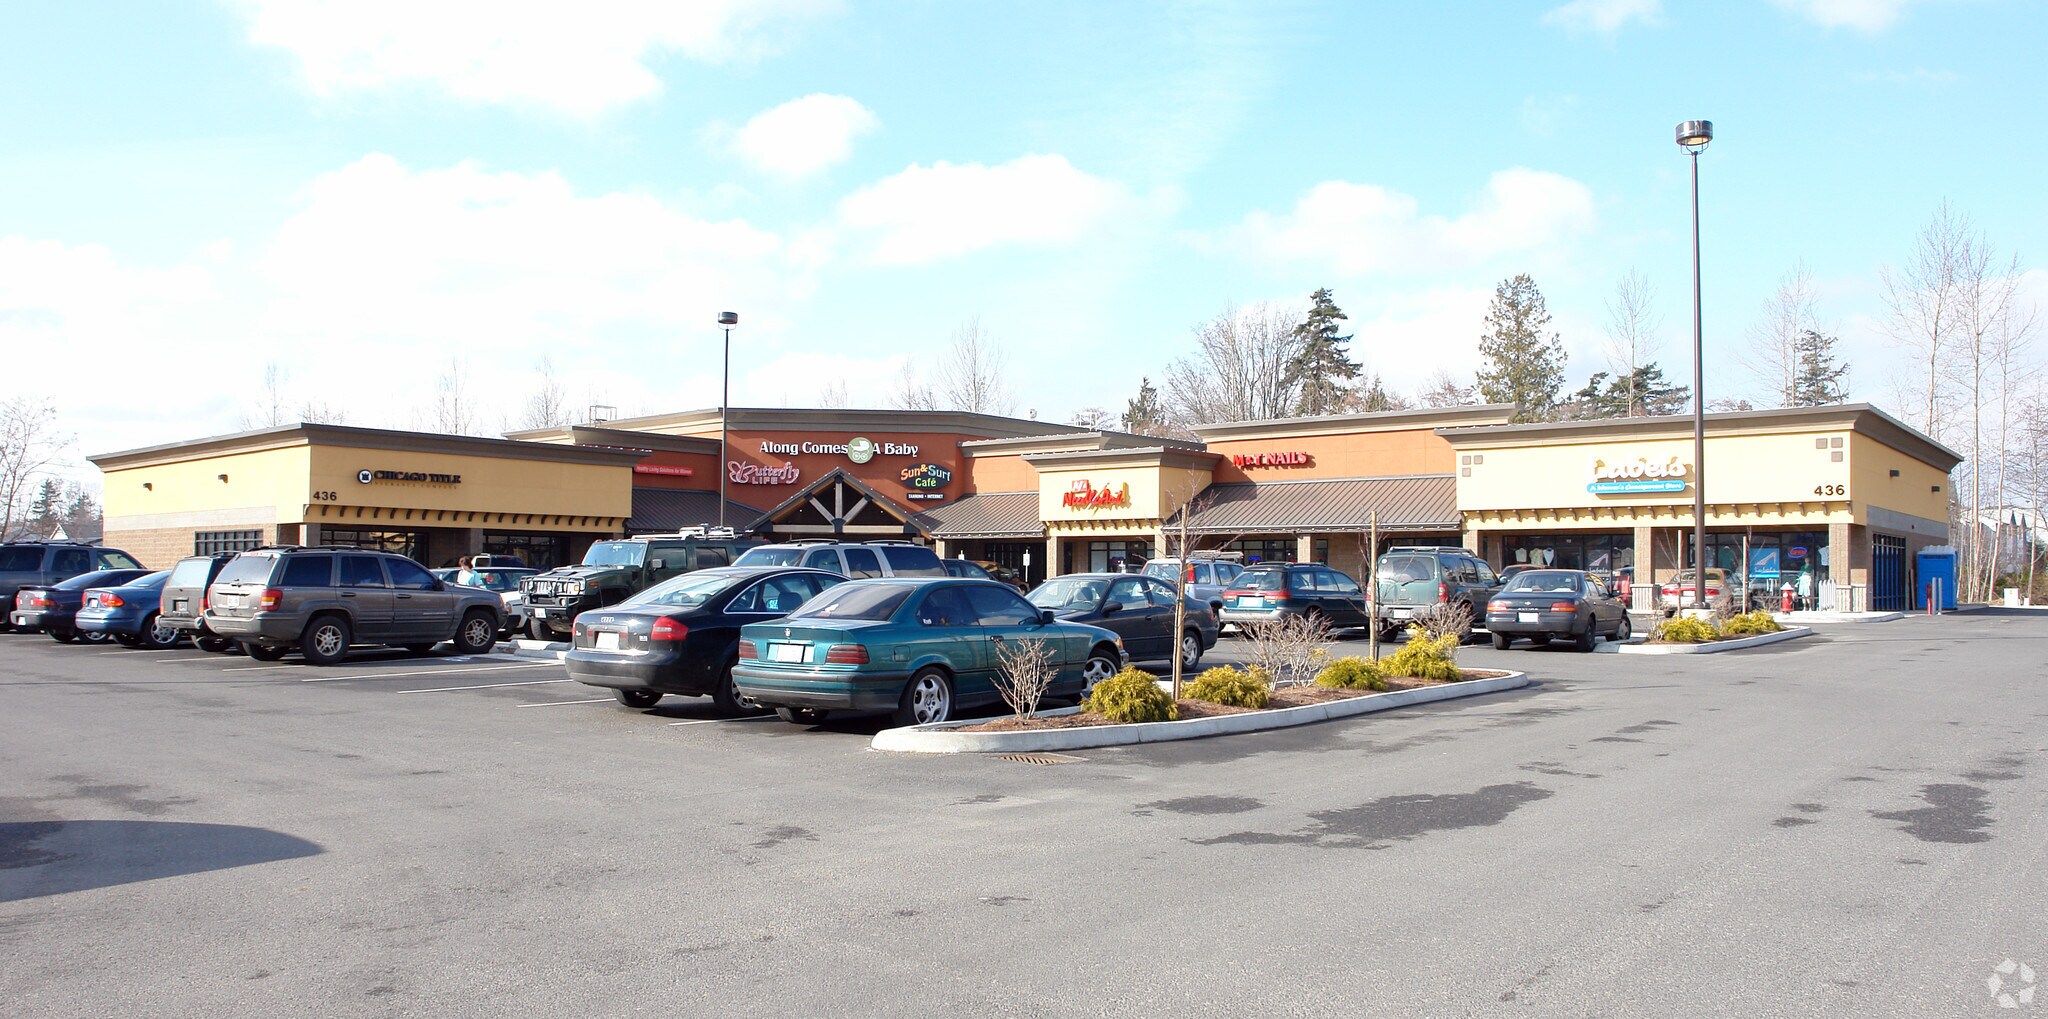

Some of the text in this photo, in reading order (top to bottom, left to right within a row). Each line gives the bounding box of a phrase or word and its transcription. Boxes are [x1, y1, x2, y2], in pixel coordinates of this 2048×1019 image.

[760, 441, 919, 457] Along Comes A Baby
[1266, 451, 1307, 465] NAILS
[373, 470, 462, 484] CHICAGO TITLE
[900, 468, 921, 481] Sun
[928, 464, 951, 482] Surf
[751, 476, 778, 485] LIFE
[313, 490, 337, 501] 436
[1813, 484, 1845, 496] 436
